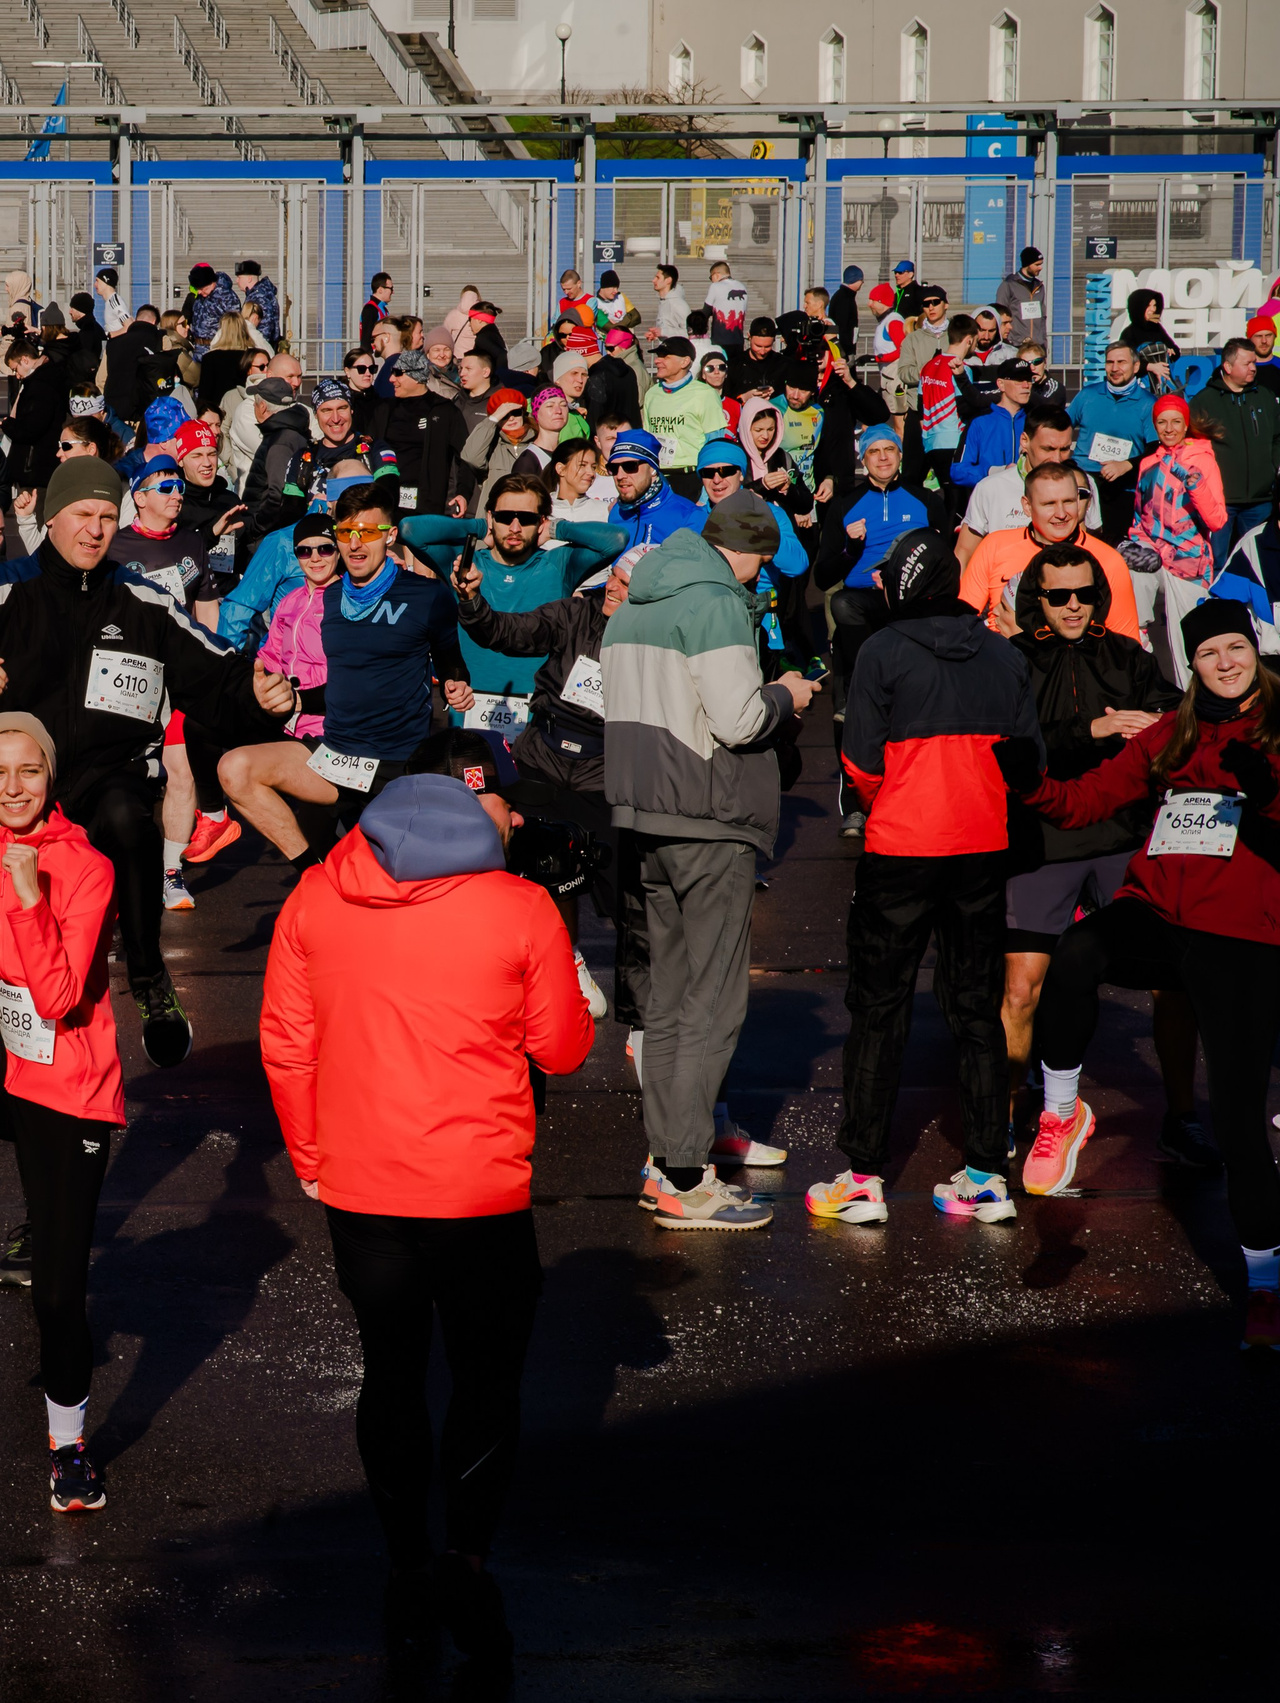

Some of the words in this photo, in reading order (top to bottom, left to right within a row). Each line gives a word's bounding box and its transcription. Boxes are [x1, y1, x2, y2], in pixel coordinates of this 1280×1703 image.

[1106, 260, 1263, 309] МОЙ
[1100, 444, 1122, 456] 6343
[121, 657, 147, 668] АРЕНА
[113, 672, 148, 694] 6110
[583, 676, 604, 694] 63
[480, 710, 512, 724] 6745
[331, 755, 361, 769] 6914
[1171, 813, 1217, 829] 6546
[558, 873, 585, 894] RONIN
[0, 987, 23, 999] АРЕНА
